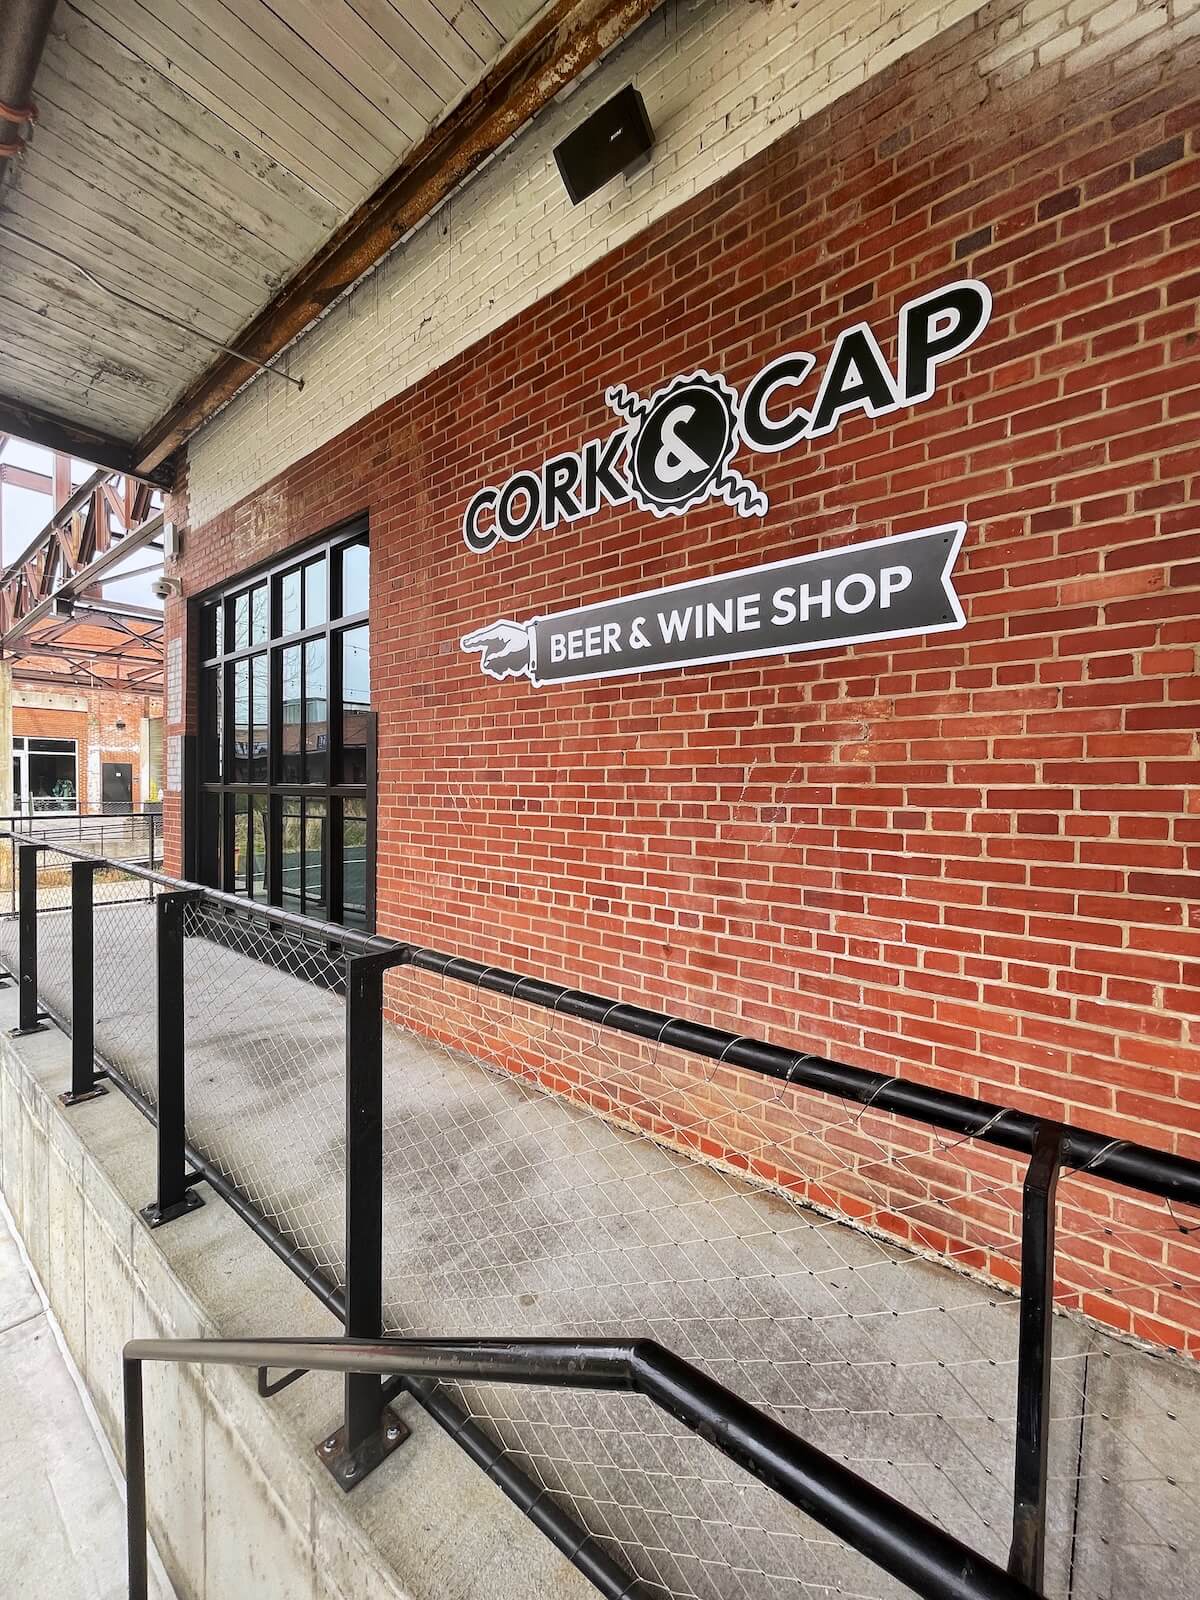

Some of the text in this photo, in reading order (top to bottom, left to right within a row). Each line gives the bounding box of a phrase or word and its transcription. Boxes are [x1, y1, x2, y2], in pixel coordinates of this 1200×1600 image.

[464, 283, 988, 551] CORK & CAP
[550, 565, 914, 664] BEER & WINE SHOP
